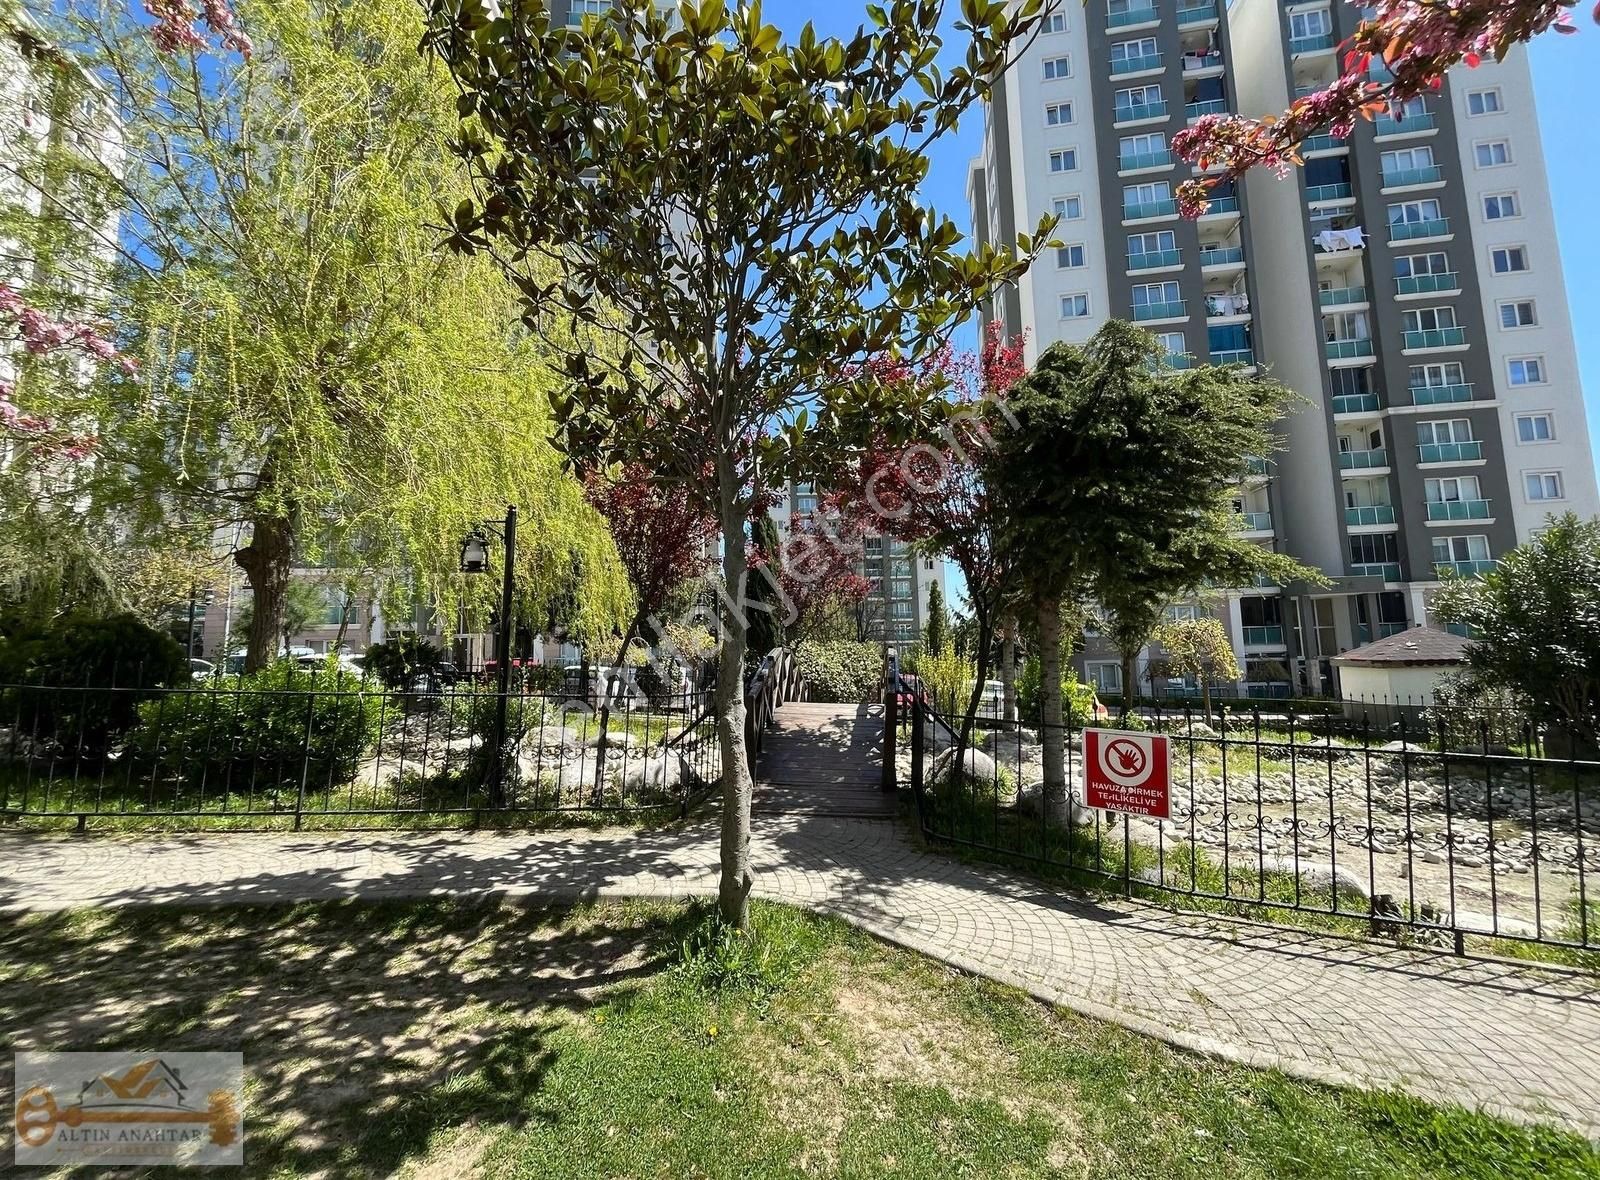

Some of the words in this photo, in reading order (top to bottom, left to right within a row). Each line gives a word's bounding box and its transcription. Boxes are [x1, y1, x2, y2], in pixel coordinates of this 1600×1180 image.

[1092, 782, 1127, 794] HAVUZA
[1105, 802, 1149, 814] YASAKTIR
[1144, 799, 1157, 807] VE
